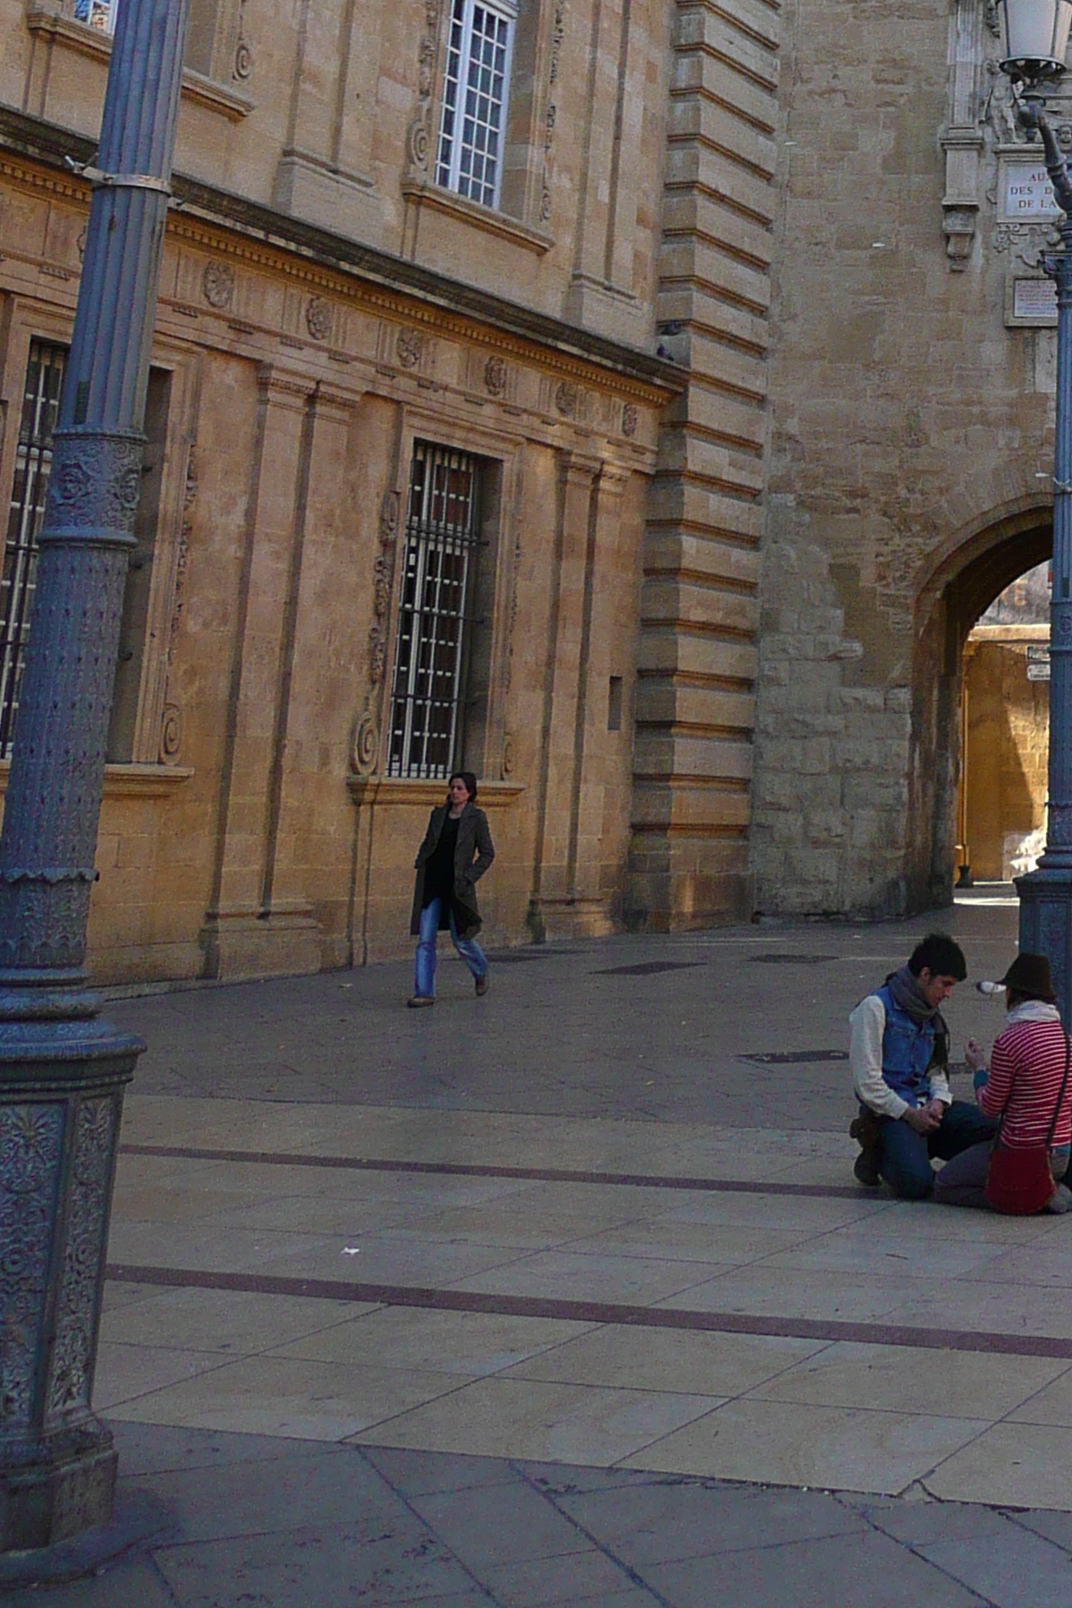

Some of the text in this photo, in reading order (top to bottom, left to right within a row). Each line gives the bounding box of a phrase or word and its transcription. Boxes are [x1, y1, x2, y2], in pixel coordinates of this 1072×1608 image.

[1029, 173, 1050, 183] AU
[1010, 186, 1034, 196] DES
[1018, 199, 1057, 209] DE LA
